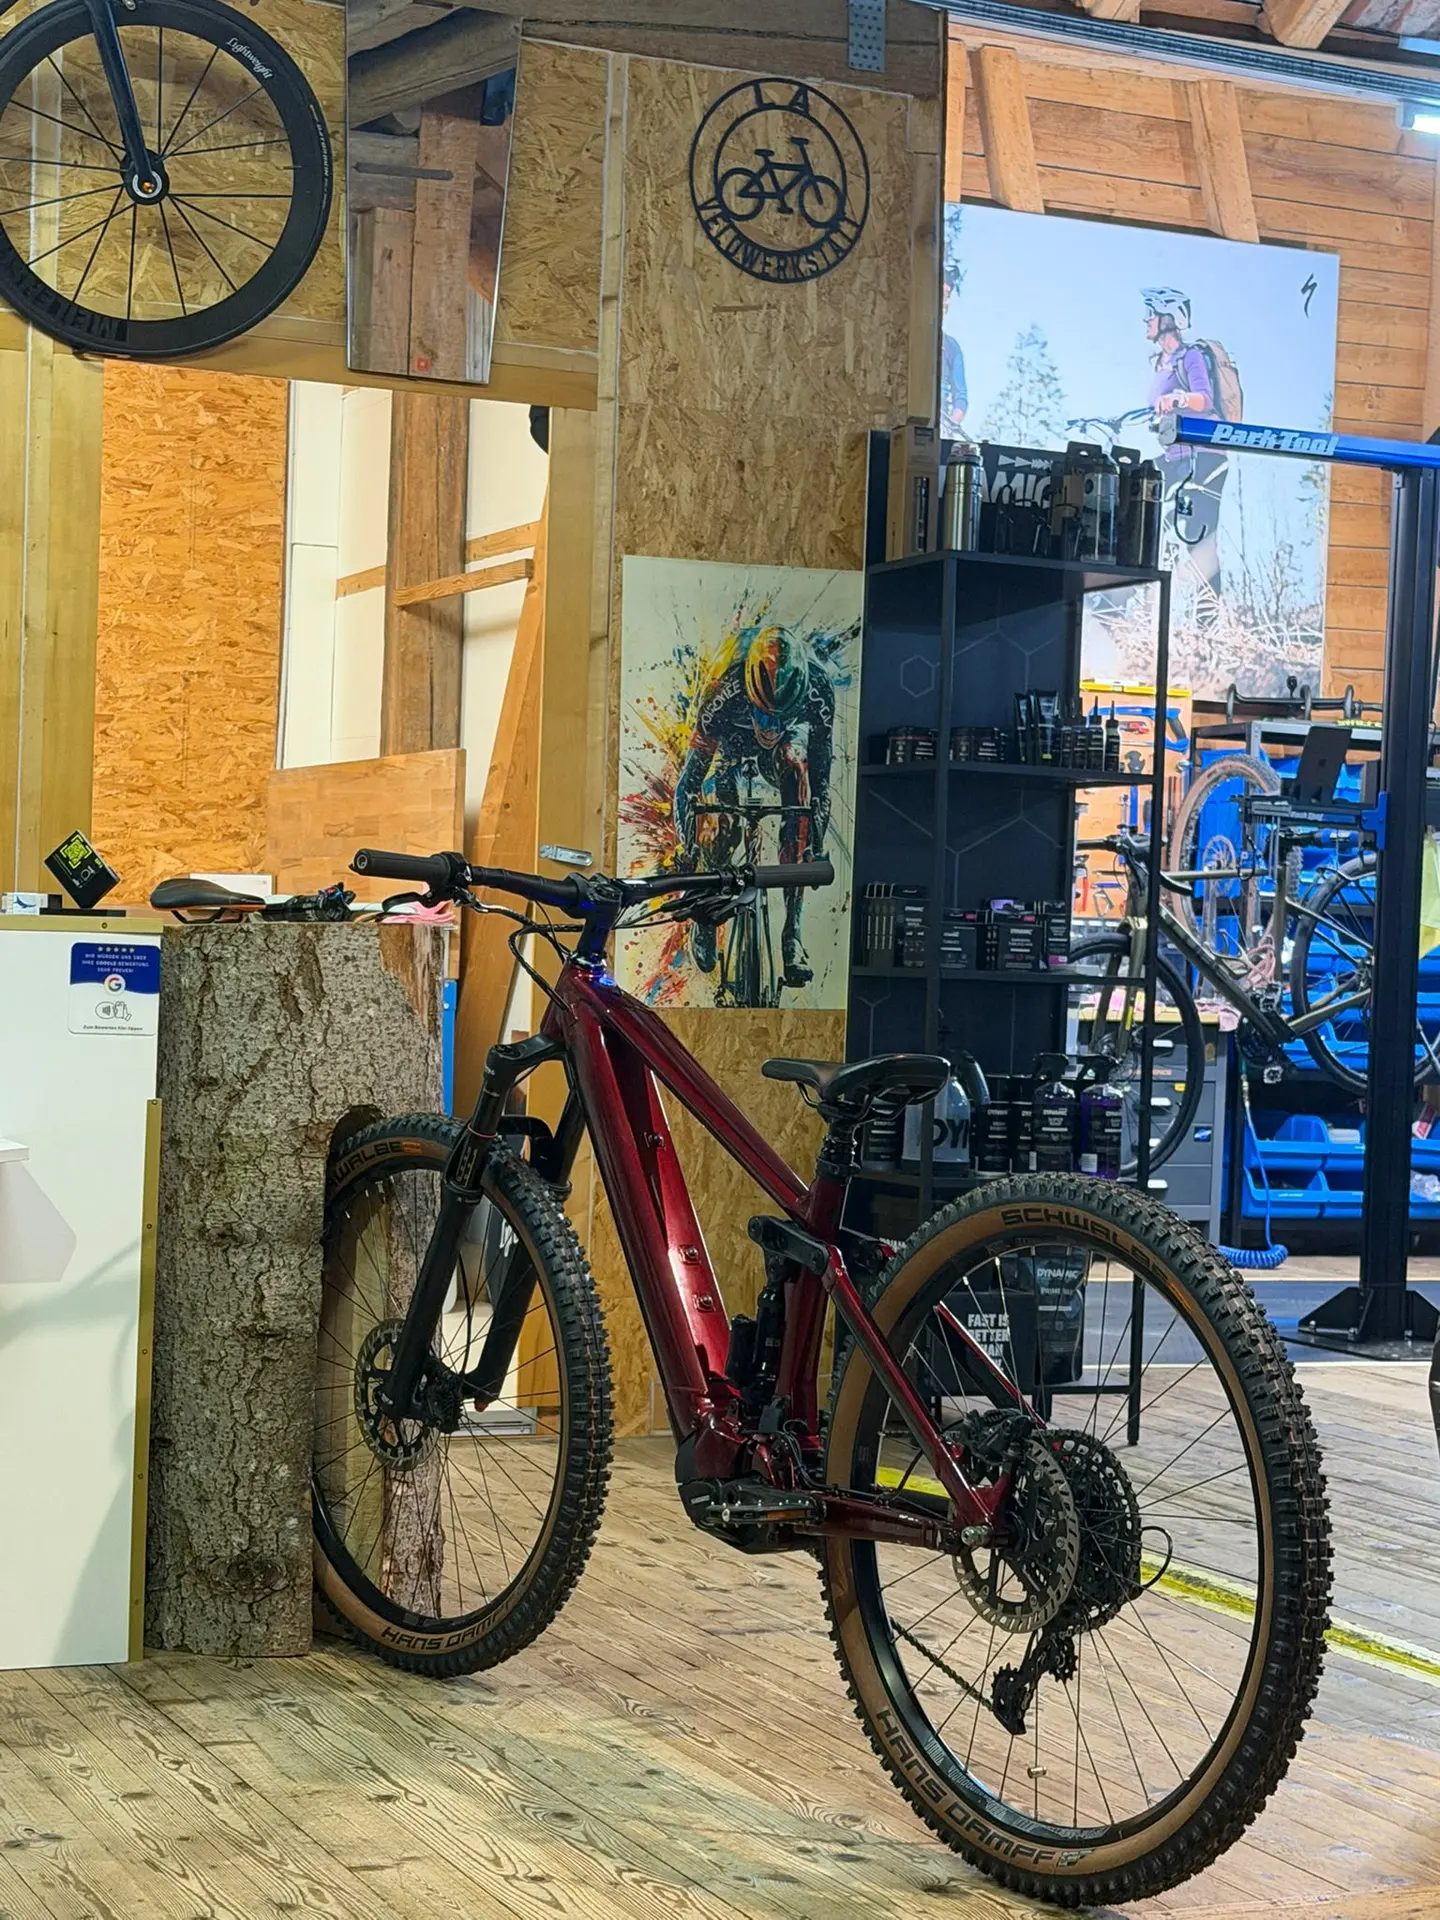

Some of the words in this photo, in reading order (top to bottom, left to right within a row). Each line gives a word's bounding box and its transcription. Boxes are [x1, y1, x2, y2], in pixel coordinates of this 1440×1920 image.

[225, 37, 274, 79] Lightweight
[698, 196, 862, 281] VELOWERKSTATT
[1001, 1207, 1170, 1281] SCHWALBE
[1036, 1268, 1080, 1279] DYNAMIC
[967, 1313, 997, 1328] FAST
[381, 1626, 443, 1651] HANS
[444, 1600, 509, 1648] DAMPF
[876, 1708, 947, 1804] HANS
[945, 1801, 1056, 1865] DAMPF
